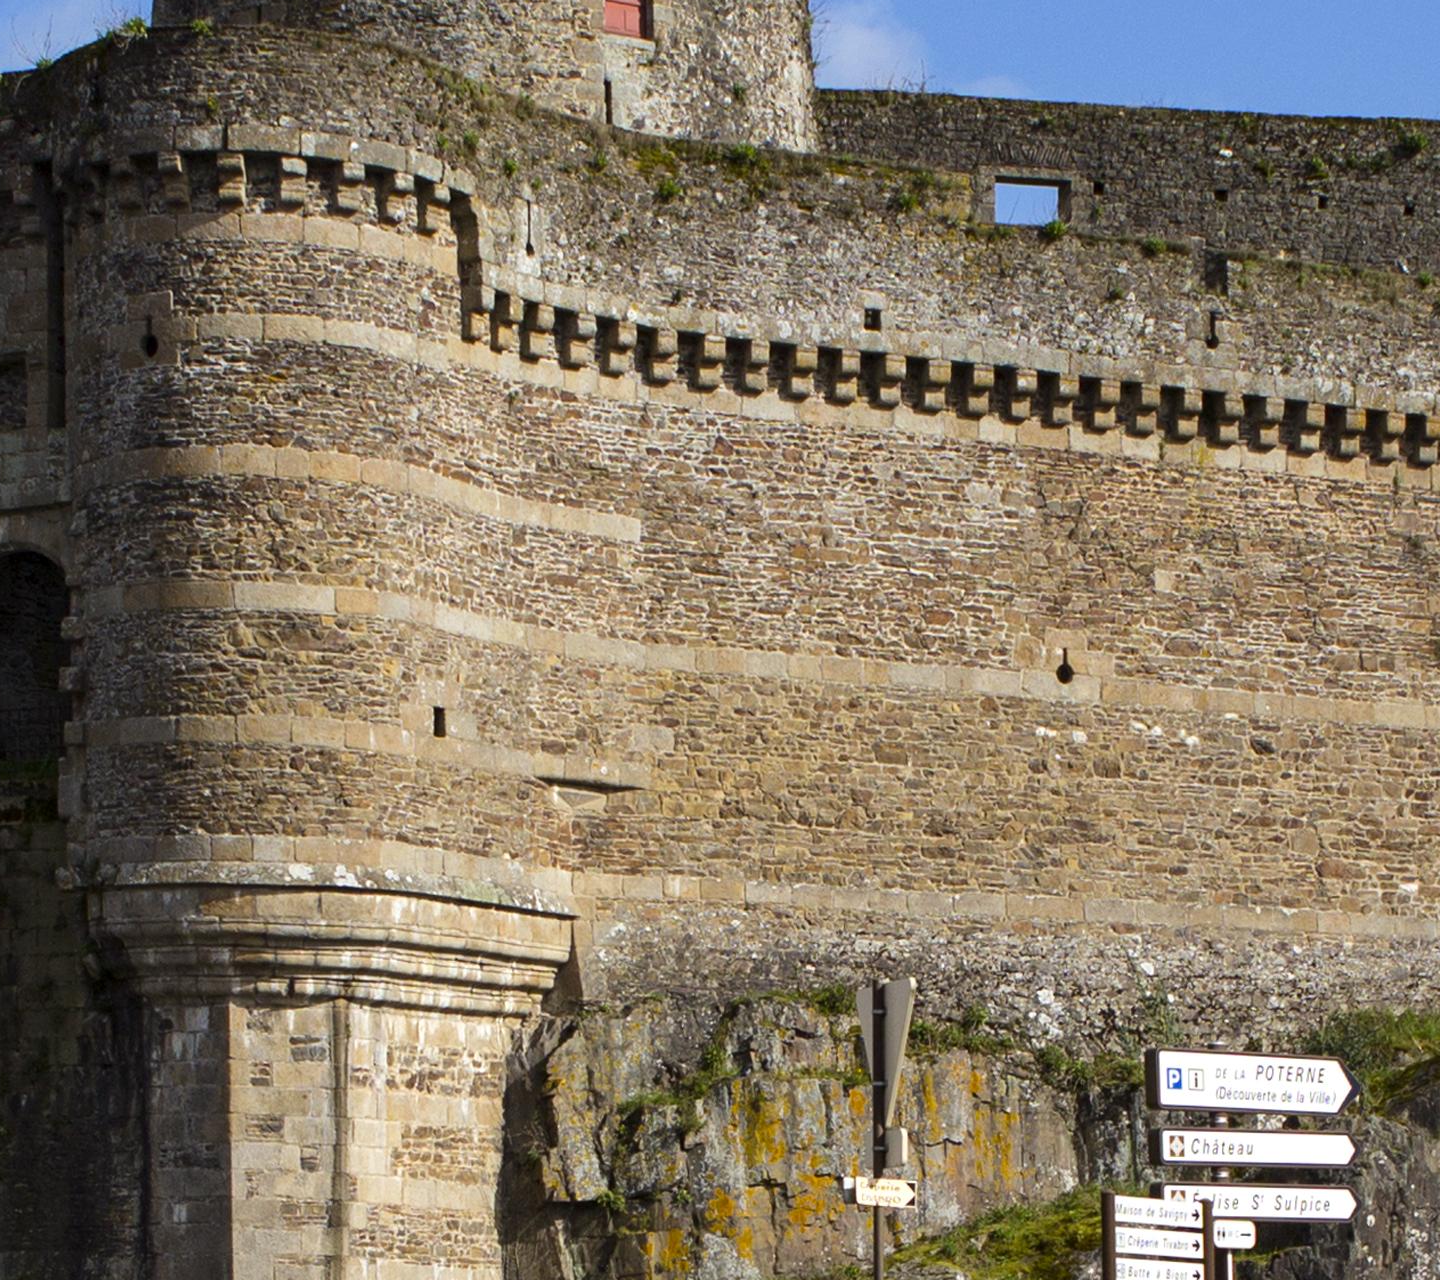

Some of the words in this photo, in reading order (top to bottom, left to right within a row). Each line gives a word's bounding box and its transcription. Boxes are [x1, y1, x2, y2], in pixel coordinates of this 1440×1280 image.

[1215, 1068, 1227, 1079] DE
[1234, 1069, 1246, 1080] LA
[1255, 1065, 1326, 1084] POTERNE
[1215, 1086, 1277, 1102] (Découverte
[1281, 1090, 1293, 1103] de
[1296, 1091, 1305, 1104] la
[1309, 1091, 1336, 1105] Ville)
[1191, 1138, 1254, 1156] Château
[1193, 1189, 1239, 1210] Élise
[1274, 1195, 1331, 1214] Sulpice
[1116, 1204, 1142, 1215] Maison
[1146, 1207, 1155, 1217] de
[1159, 1207, 1188, 1222] Savigny
[1128, 1265, 1150, 1279] Butte
